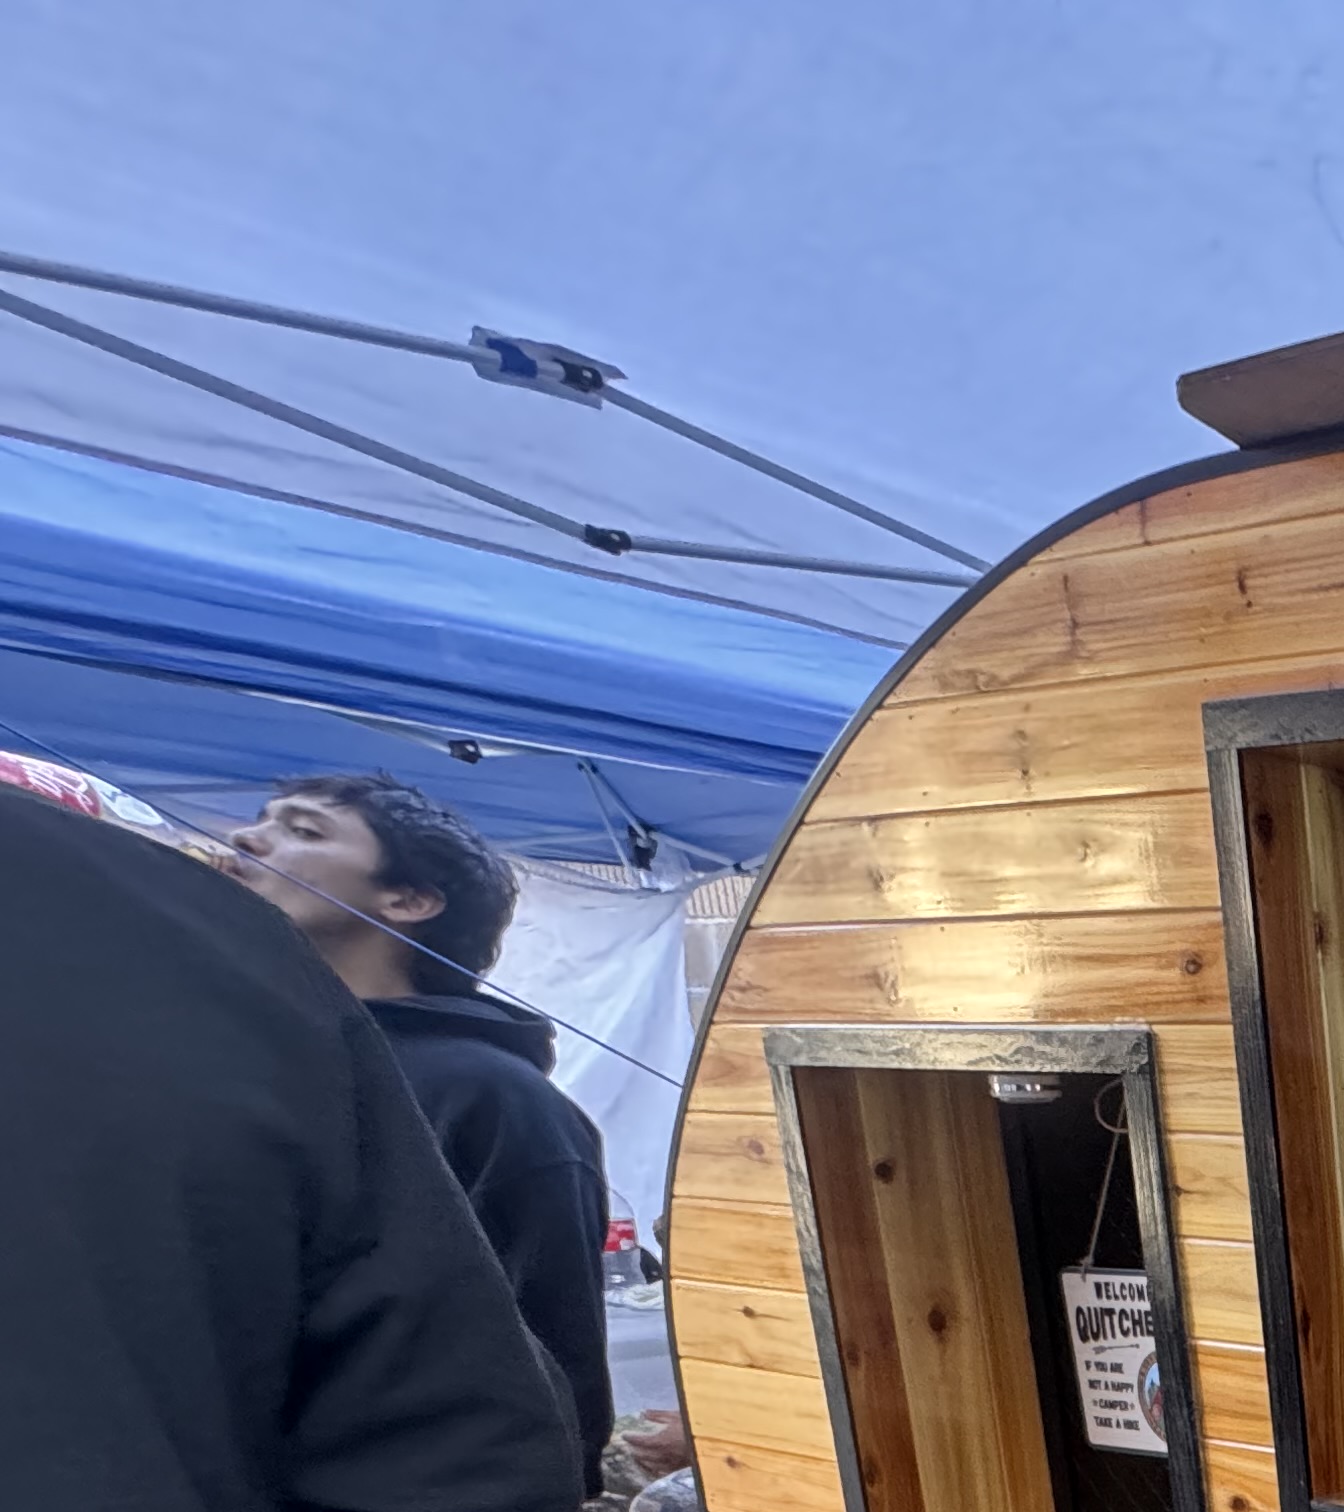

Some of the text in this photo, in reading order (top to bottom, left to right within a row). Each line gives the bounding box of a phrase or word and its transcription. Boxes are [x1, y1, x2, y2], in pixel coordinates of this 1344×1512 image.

[1075, 1305, 1154, 1344] QUITCHE
[1104, 1381, 1110, 1391] A
[1111, 1381, 1134, 1393] HAPPY
[1099, 1399, 1129, 1411] CAMPER
[1094, 1416, 1113, 1428] TAKE
[1115, 1417, 1122, 1429] A
